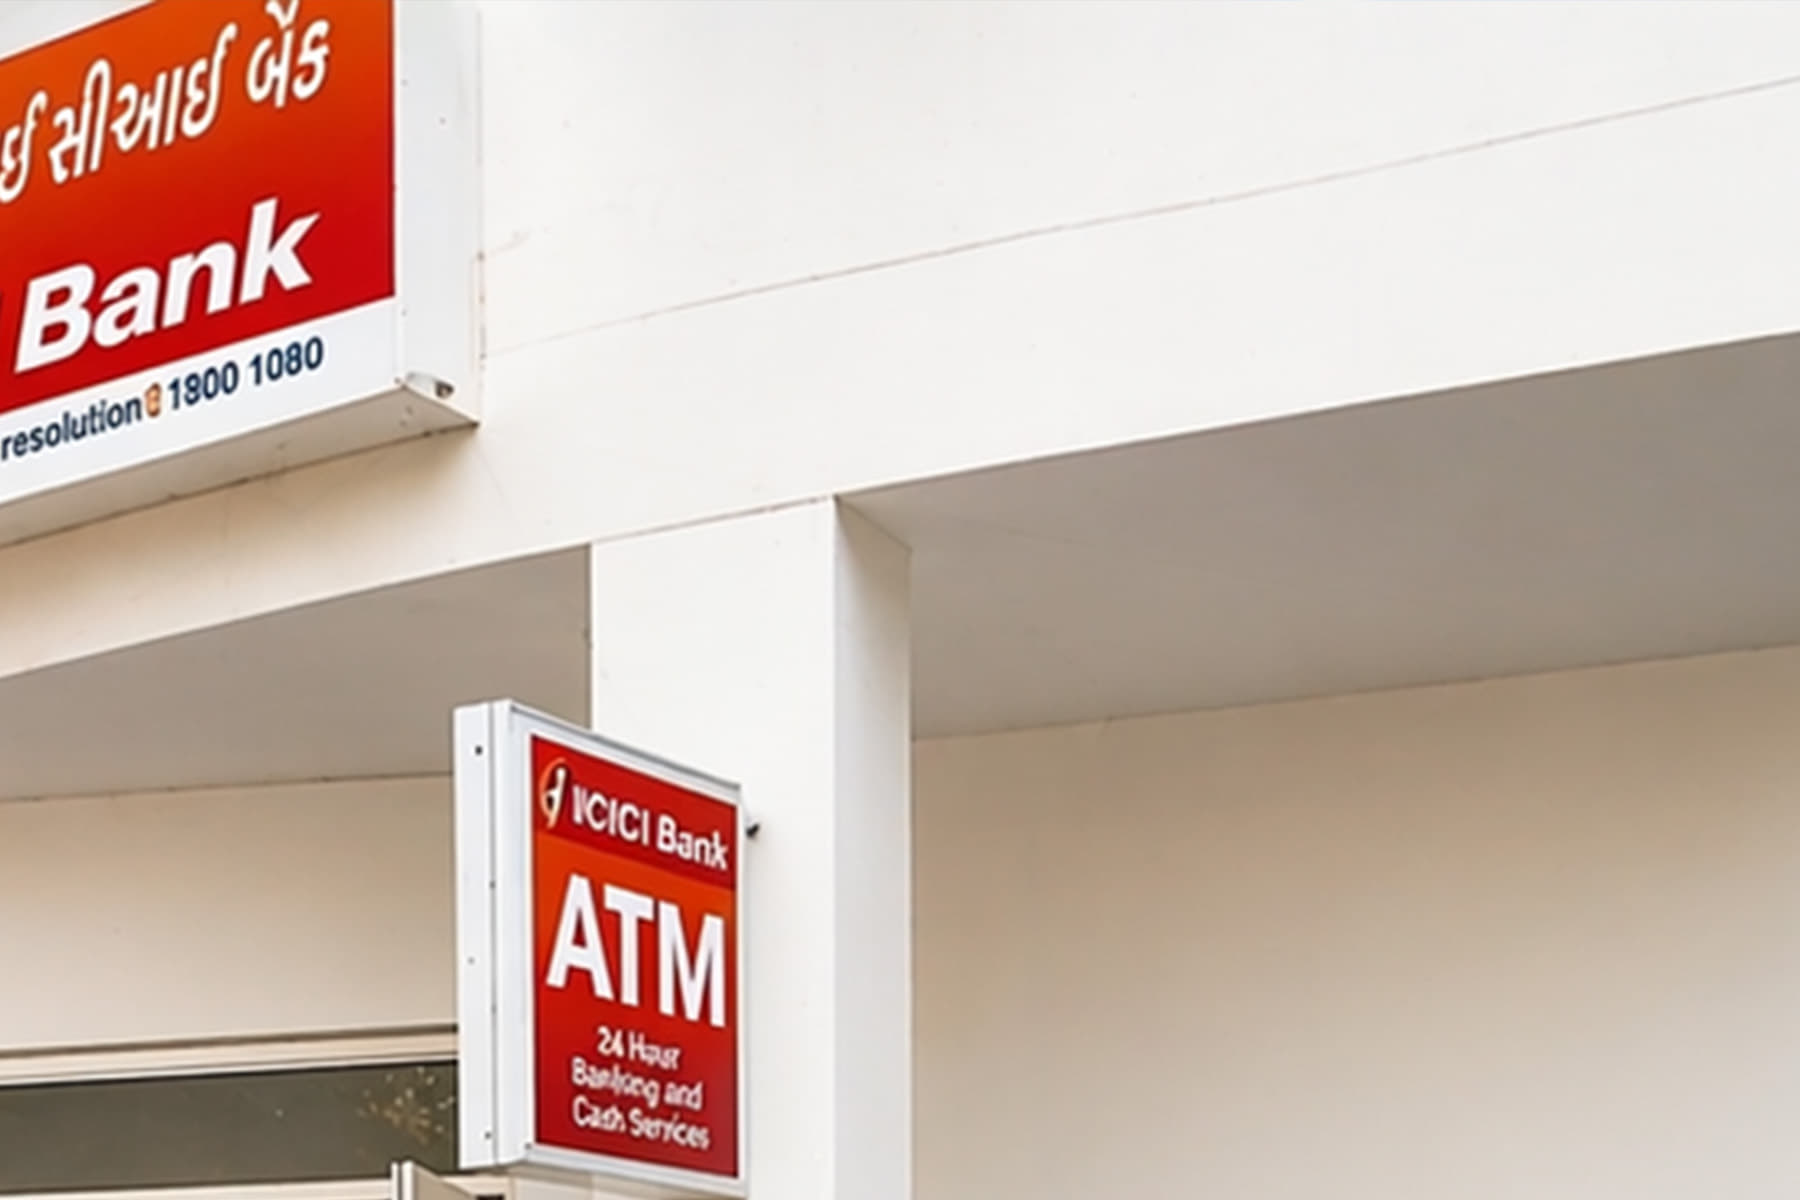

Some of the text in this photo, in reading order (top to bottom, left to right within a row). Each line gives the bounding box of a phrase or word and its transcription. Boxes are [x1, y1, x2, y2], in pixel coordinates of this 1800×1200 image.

[14, 197, 320, 374] Bank
[0, 396, 143, 462] resolution
[166, 360, 240, 411] 1800
[248, 335, 325, 386] 1080
[656, 813, 728, 871] Bank
[546, 873, 726, 1028] ATM
[597, 1025, 681, 1070] 24 Hour
[572, 1094, 710, 1149] Cash Services
[663, 1081, 703, 1111] and
